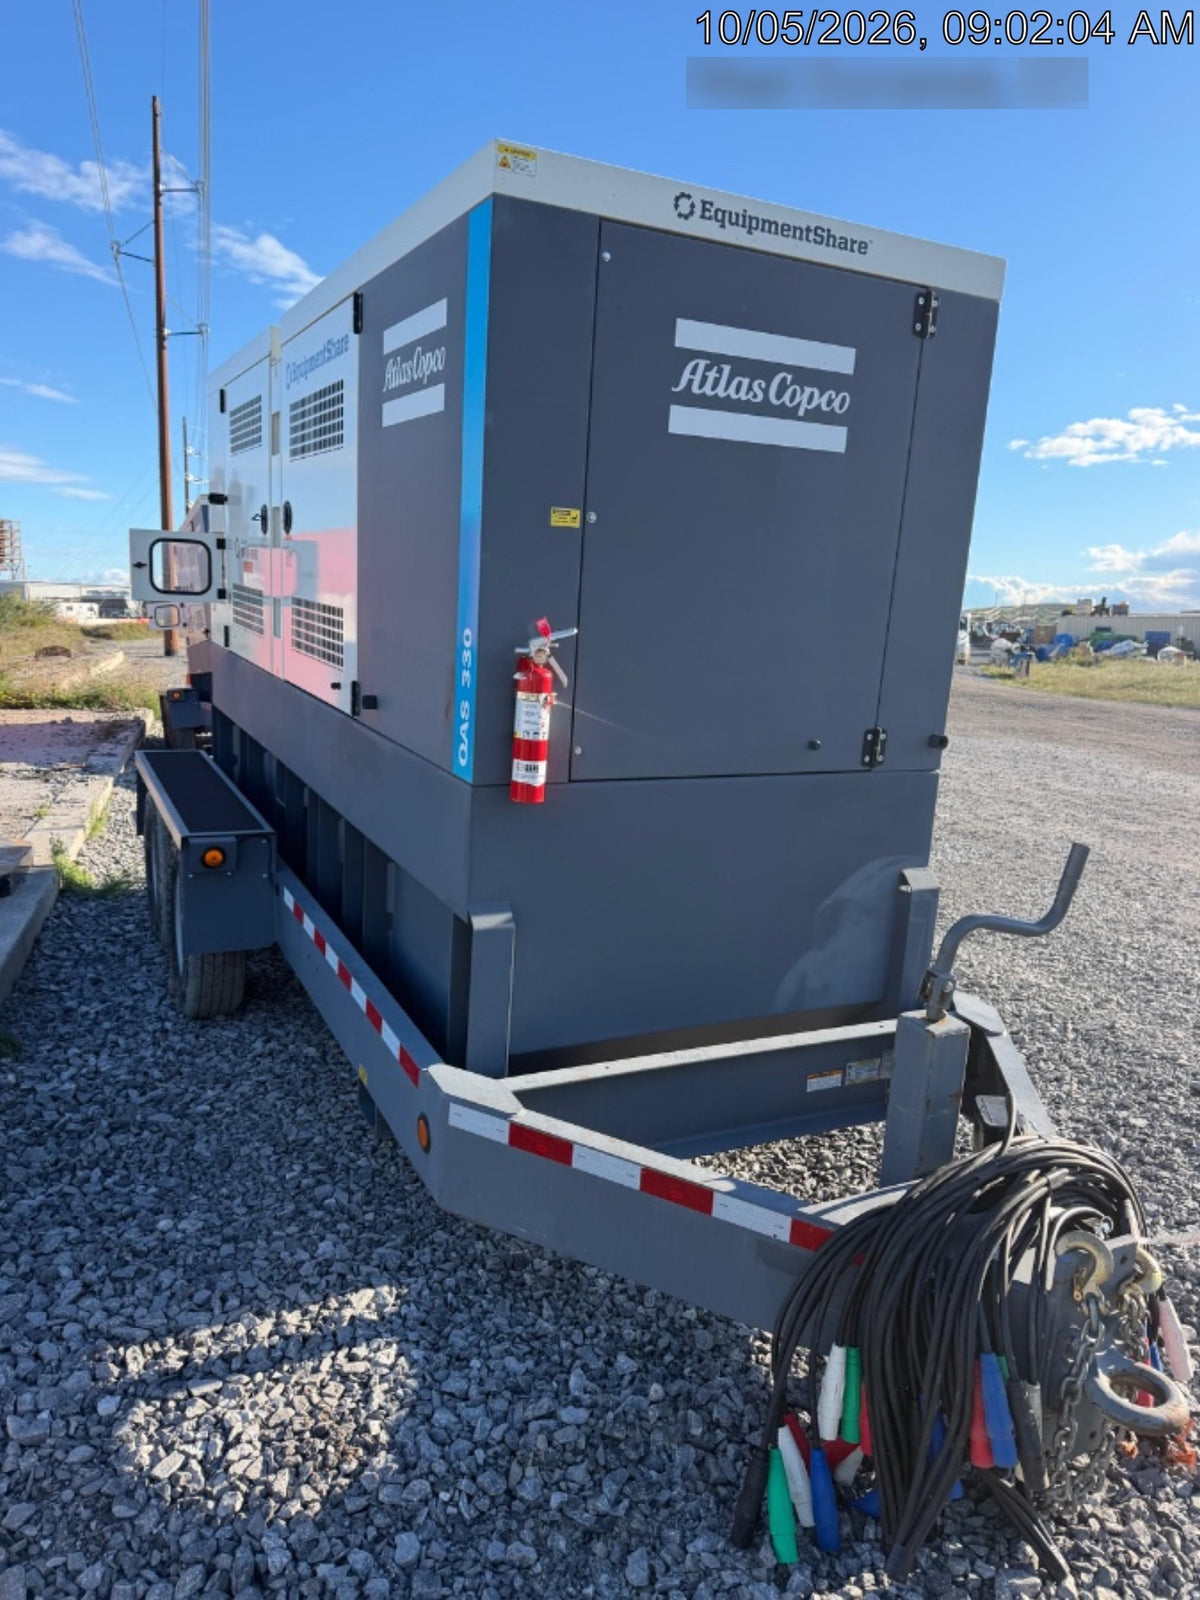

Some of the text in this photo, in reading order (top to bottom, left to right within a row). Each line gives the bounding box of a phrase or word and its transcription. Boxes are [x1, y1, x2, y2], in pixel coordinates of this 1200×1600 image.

[699, 198, 869, 255] EquipmentShare
[292, 333, 350, 384] EquipmentShare
[461, 627, 473, 689] 330
